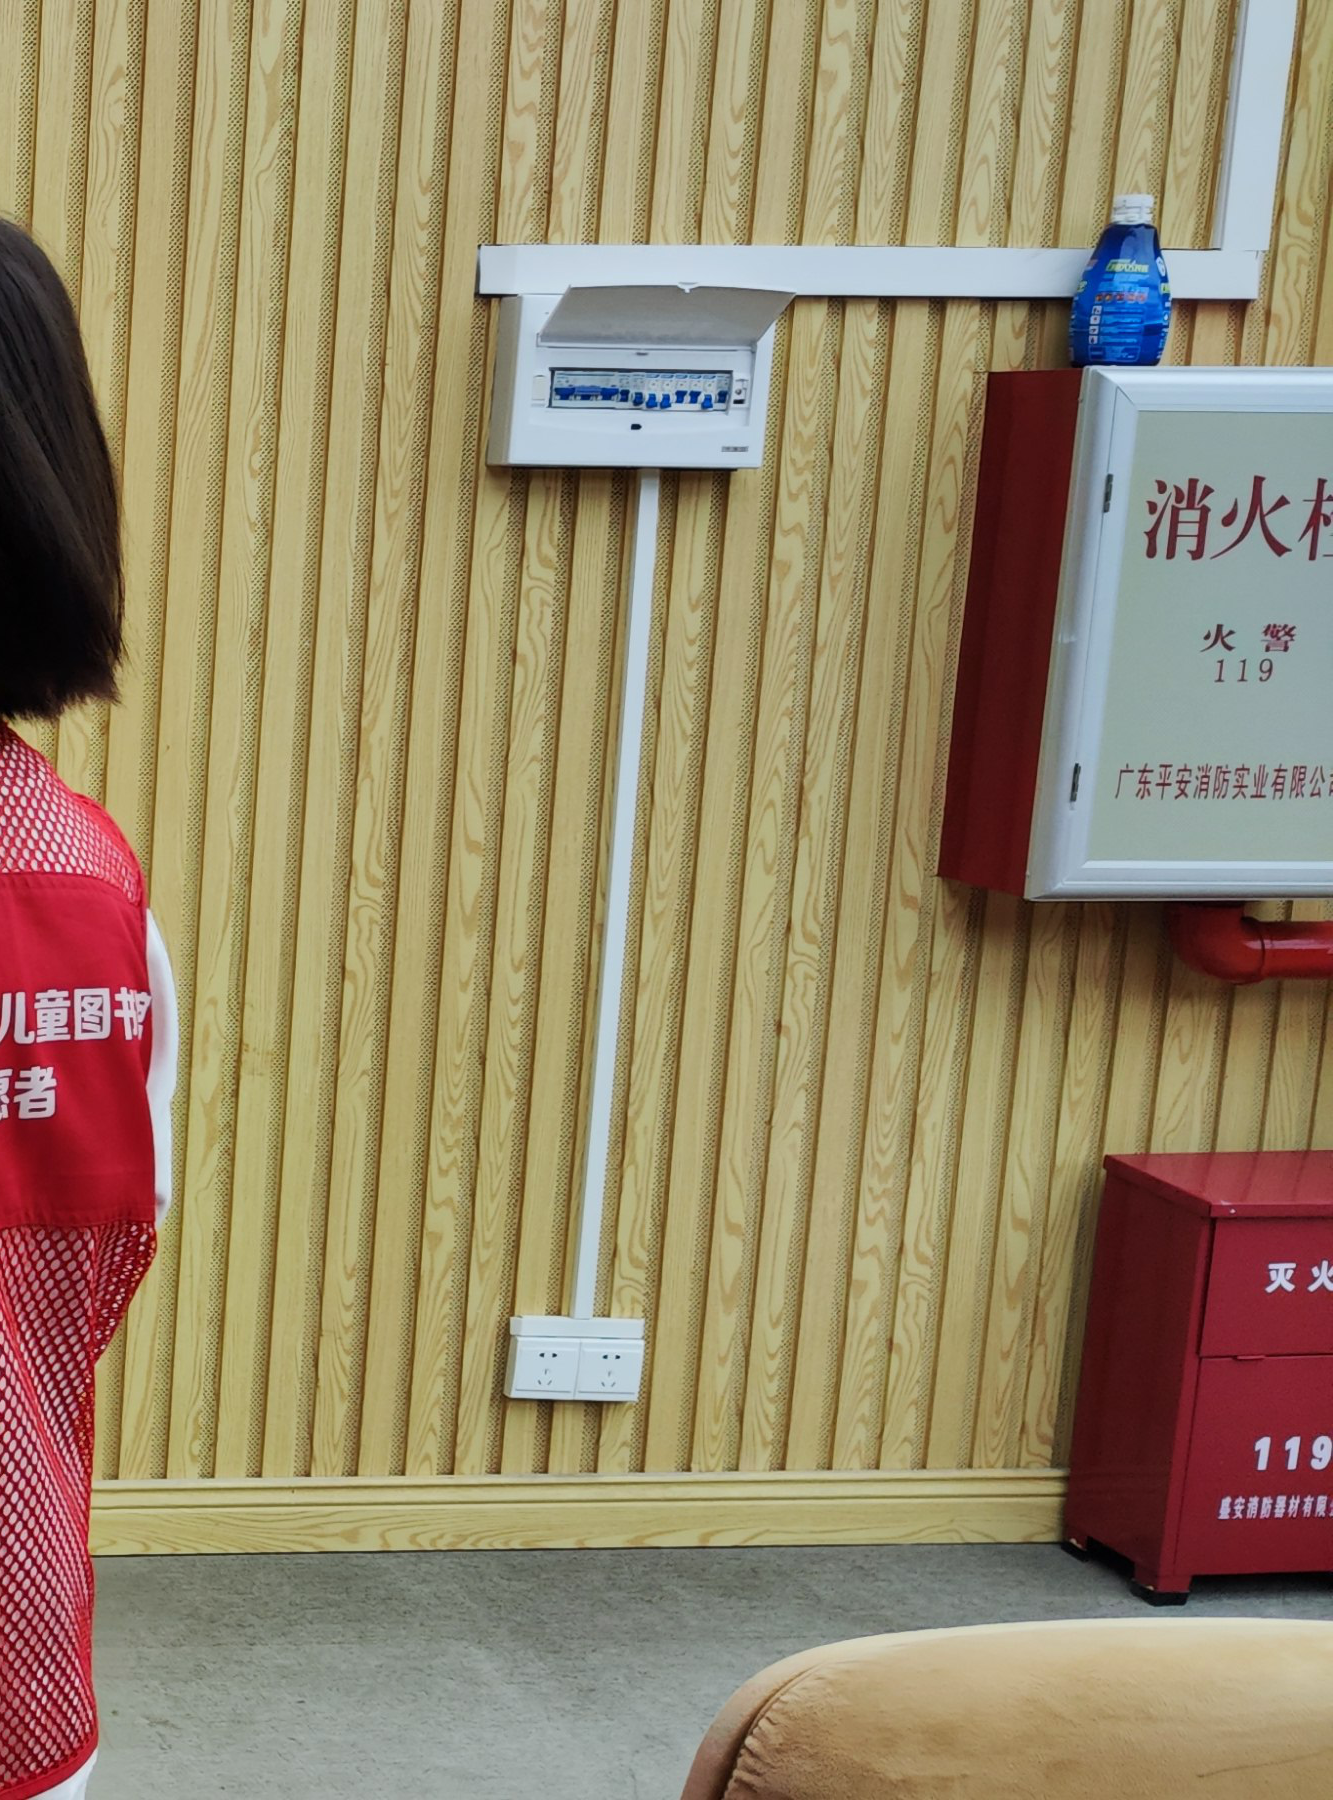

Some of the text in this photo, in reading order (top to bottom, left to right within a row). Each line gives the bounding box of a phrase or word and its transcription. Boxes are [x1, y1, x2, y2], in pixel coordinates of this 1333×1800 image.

[1213, 658, 1274, 683] 119
[1114, 762, 1333, 801] 广东平安消防实业有限公
[1254, 1435, 1333, 1471] 119
[1218, 1495, 1333, 1520] 盛安消防器材有限
